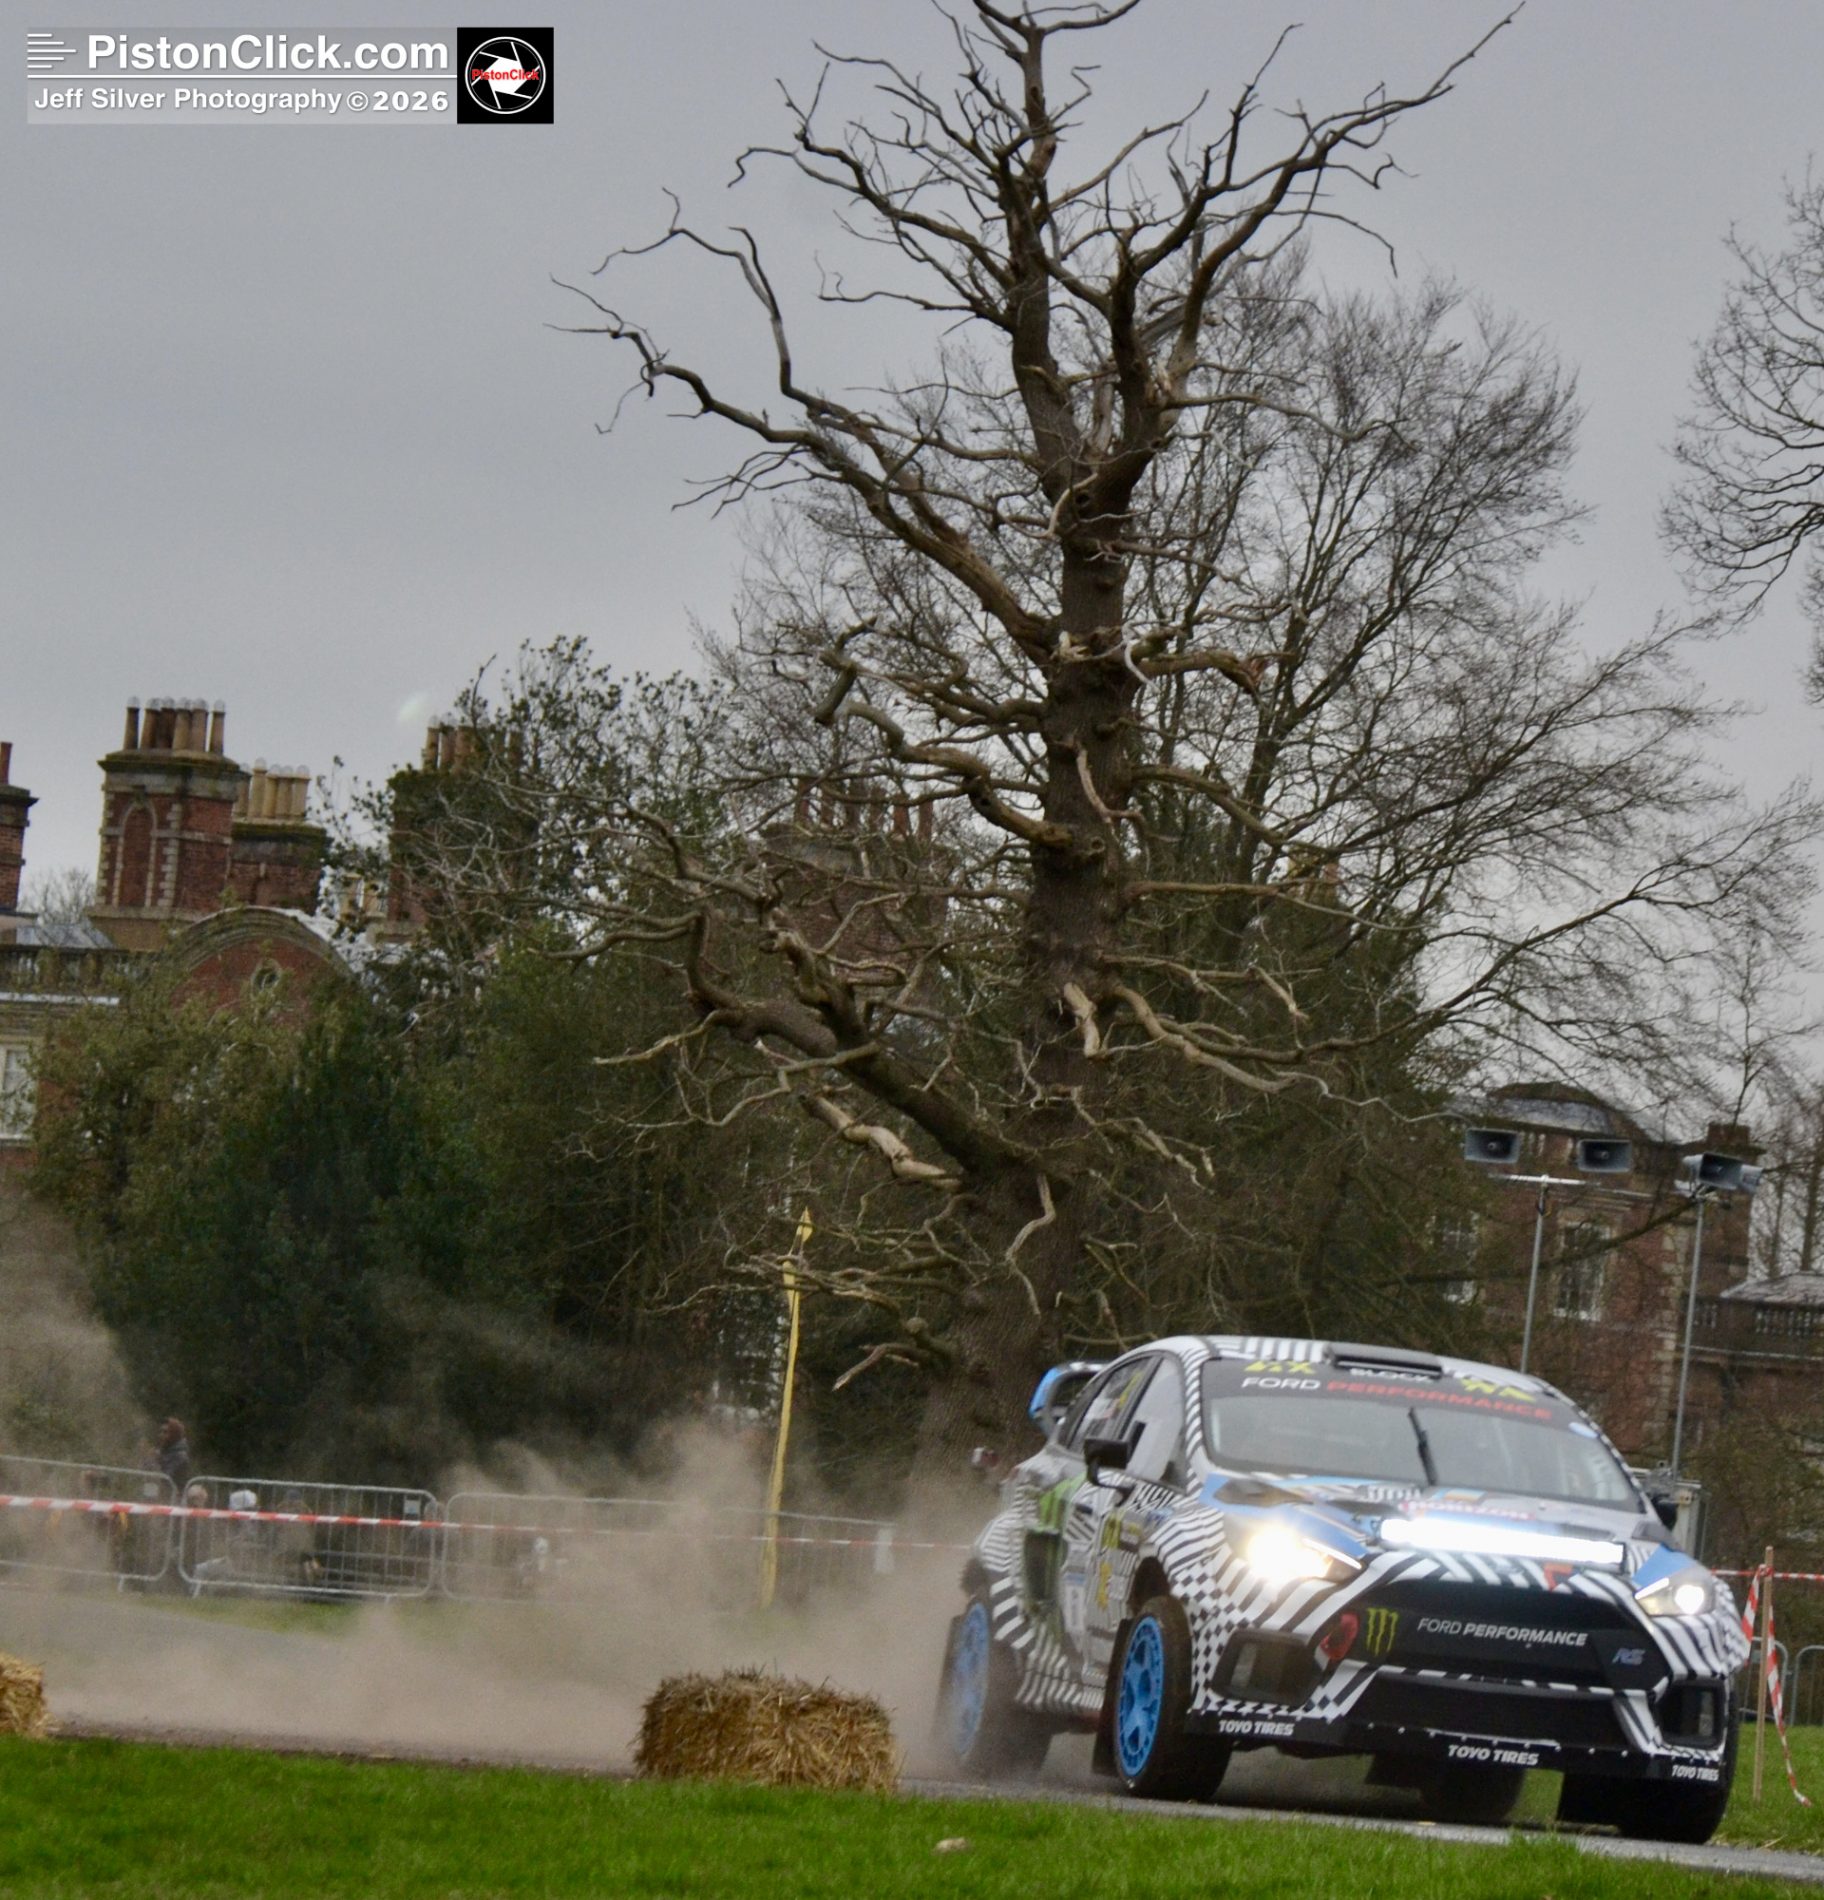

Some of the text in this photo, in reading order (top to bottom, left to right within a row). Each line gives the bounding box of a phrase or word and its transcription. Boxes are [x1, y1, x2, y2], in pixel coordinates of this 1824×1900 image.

[1241, 1377, 1321, 1391] FORD
[1327, 1379, 1553, 1420] PERFORMANCE
[1417, 1617, 1588, 1647] FORD PERFORMANCE
[1219, 1719, 1295, 1736] TOYO TIRES
[1448, 1744, 1539, 1766] TOYO TIRES
[1671, 1764, 1697, 1779] TOYO
